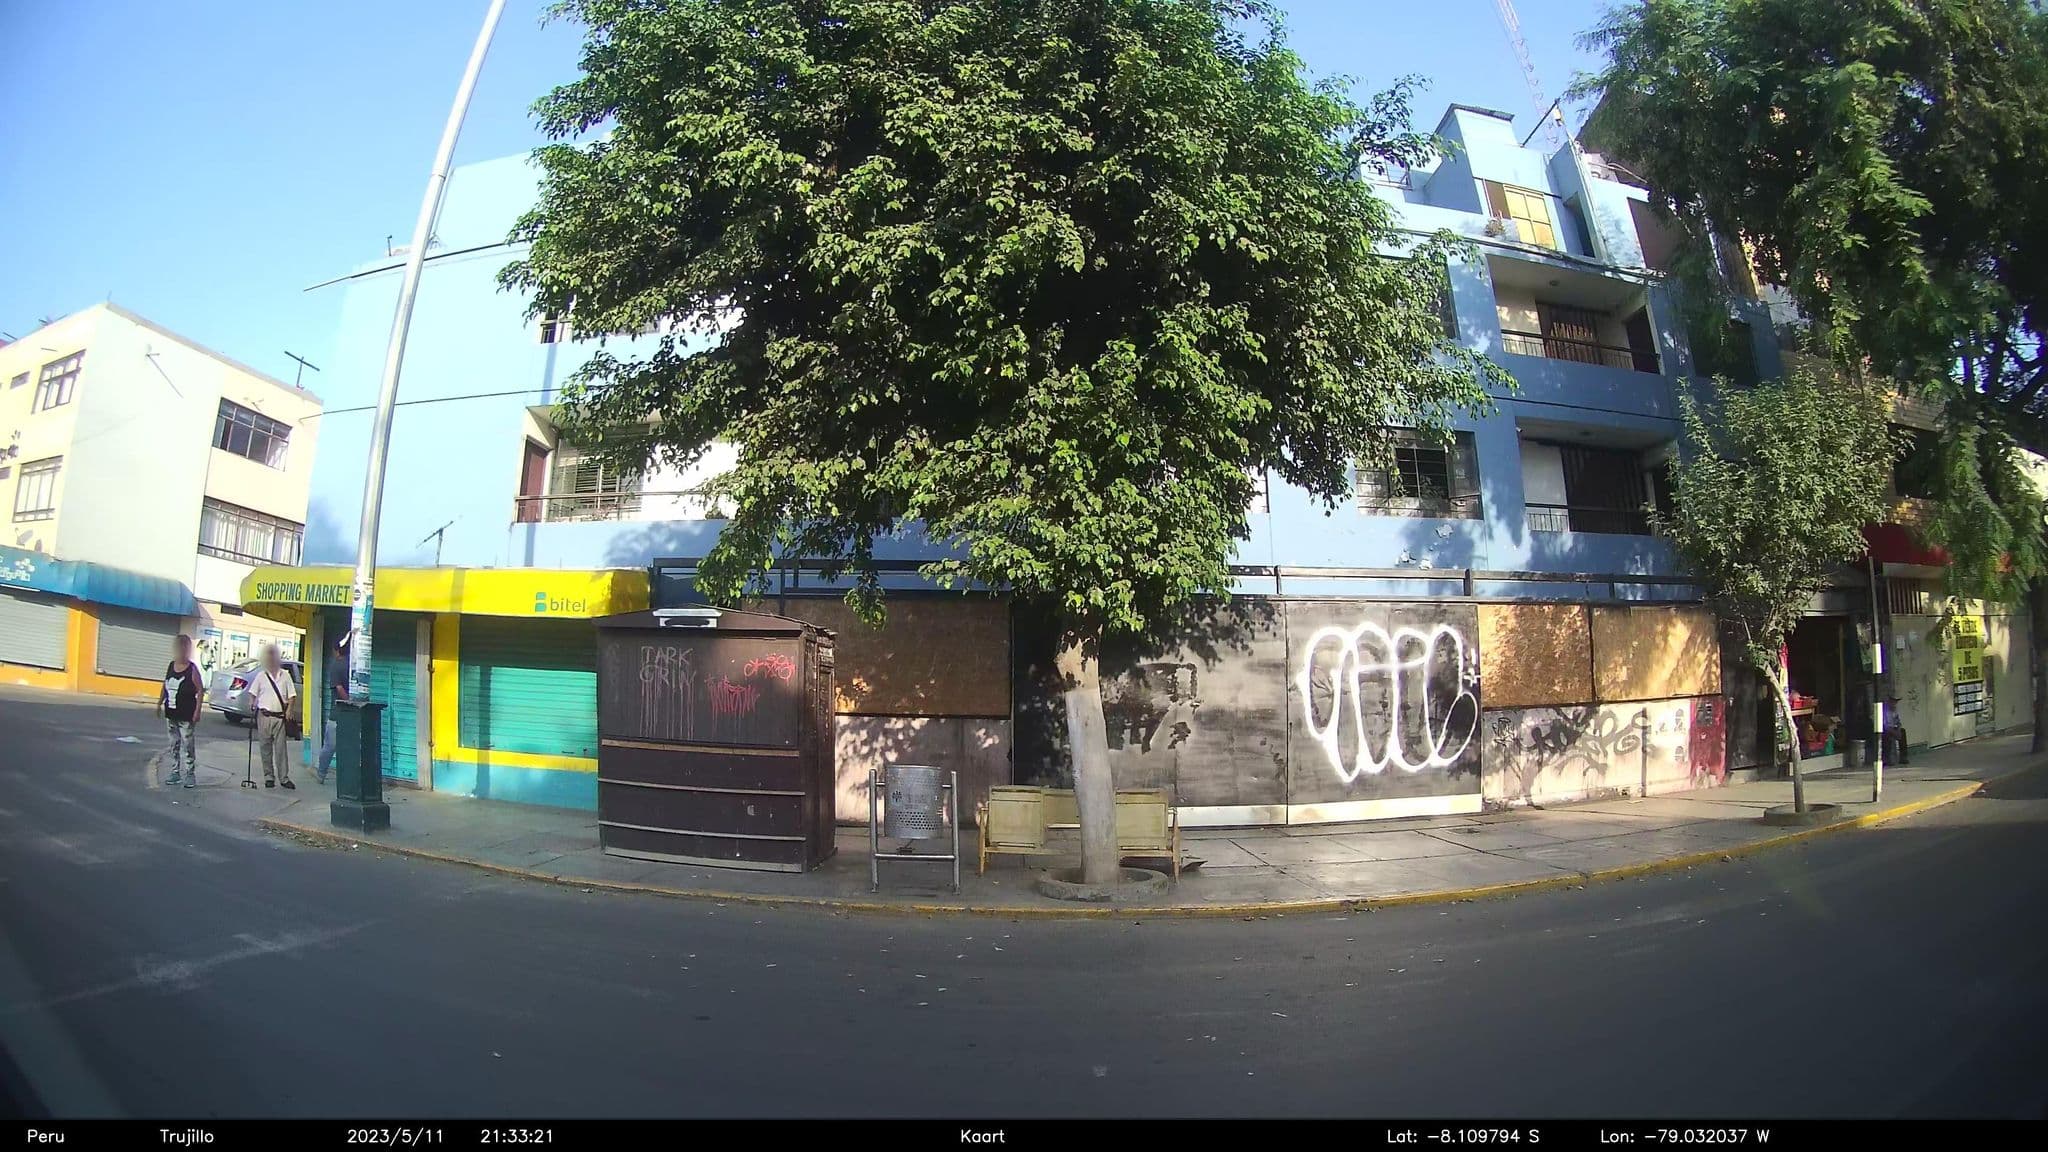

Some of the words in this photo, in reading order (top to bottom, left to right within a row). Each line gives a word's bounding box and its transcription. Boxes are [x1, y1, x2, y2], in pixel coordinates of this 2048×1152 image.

[256, 582, 302, 601] SHOPPING
[305, 583, 351, 604] MARKET
[550, 597, 586, 613] bitel
